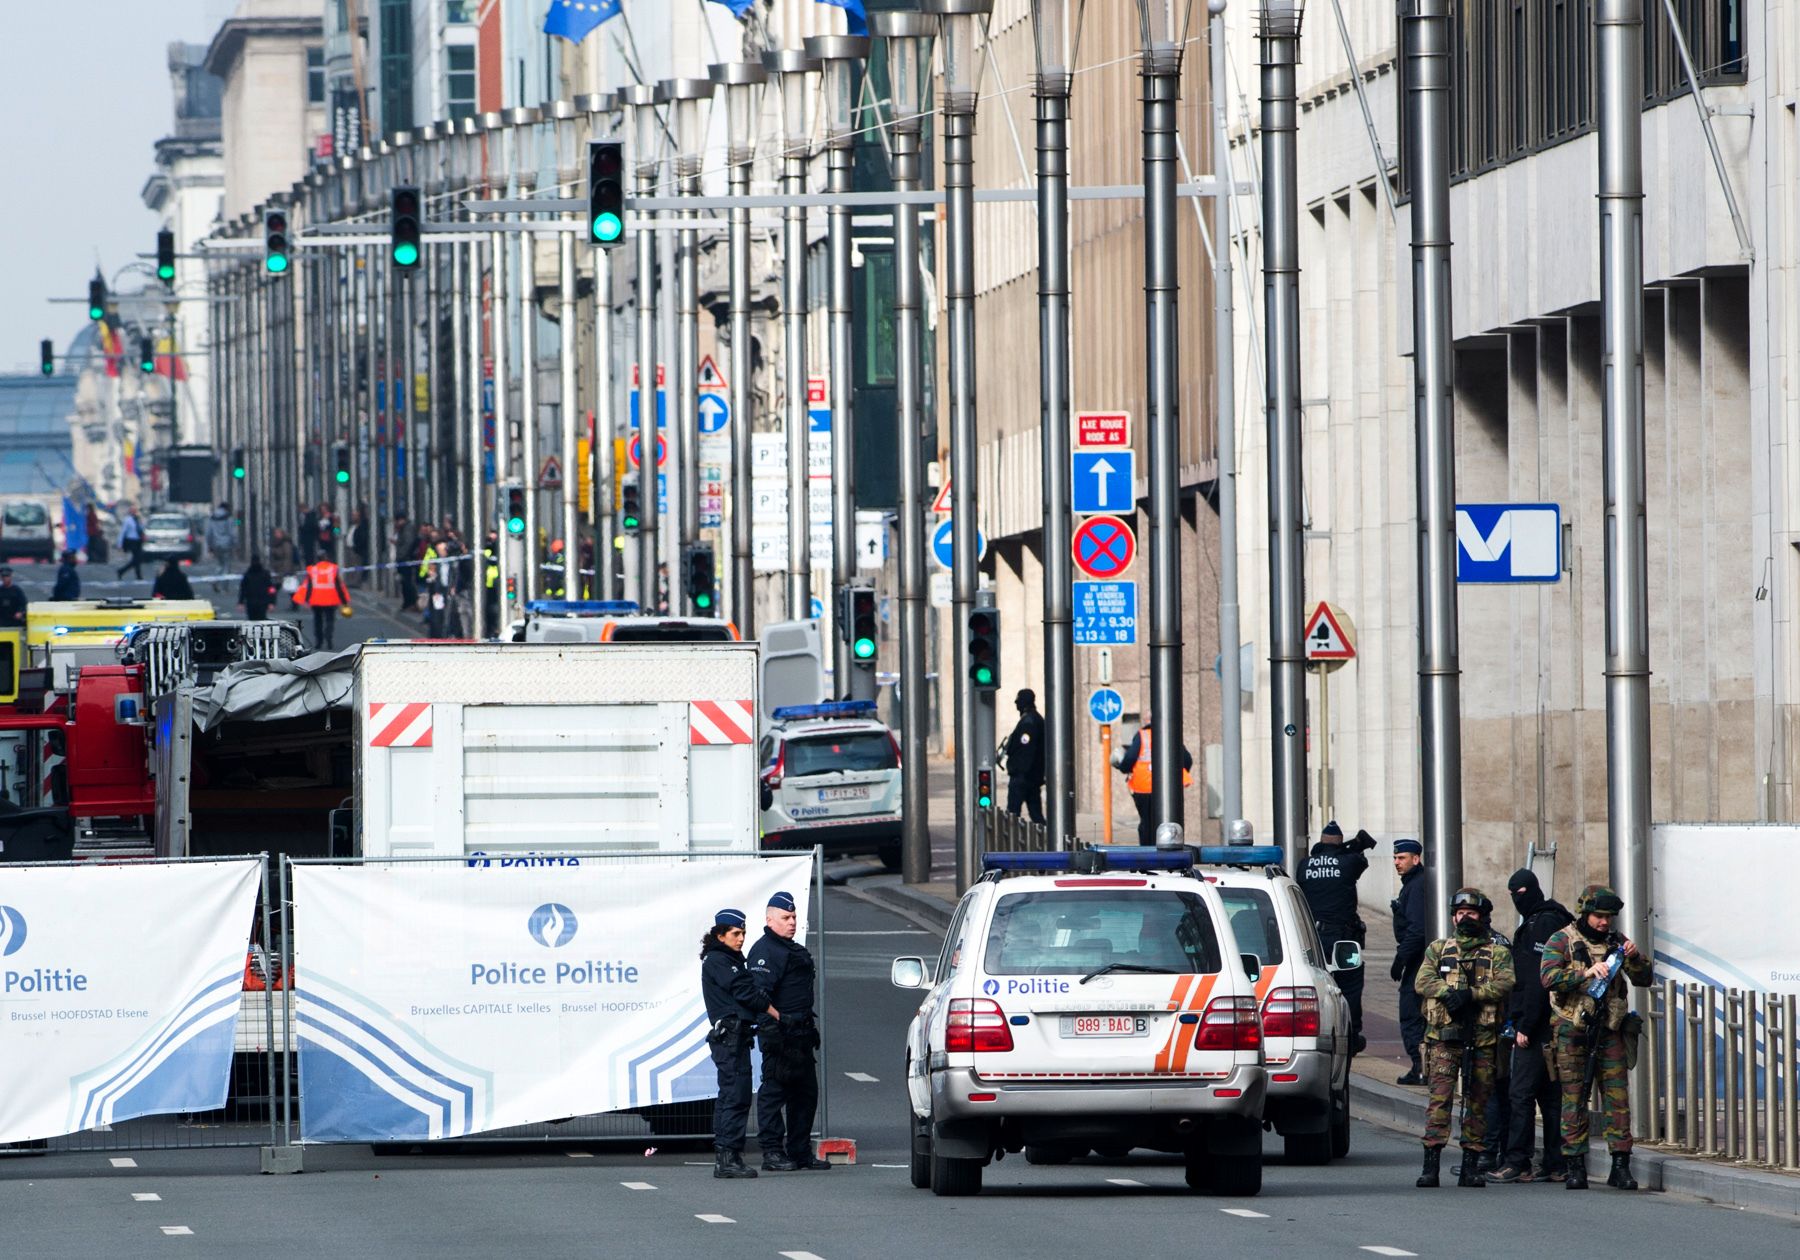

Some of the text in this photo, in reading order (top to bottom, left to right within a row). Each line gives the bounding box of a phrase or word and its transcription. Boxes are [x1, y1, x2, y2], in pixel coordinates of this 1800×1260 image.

[1081, 420, 1123, 429] AXE ROUGE
[1085, 432, 1120, 441] RODE AS
[1087, 617, 1096, 627] 7
[1109, 616, 1134, 627] 9.30
[1085, 630, 1098, 641] 13
[1115, 630, 1128, 641] 18
[801, 806, 829, 815] Politie
[1308, 856, 1339, 867] Police
[1305, 867, 1341, 879] Politie
[471, 960, 639, 985] Police Politie
[5, 968, 88, 992] Politie
[1008, 978, 1070, 994] Politie
[11, 1007, 149, 1021] Brussel HOOFDSTAD Elsene
[411, 1005, 461, 1016] Bruxelles
[463, 1003, 513, 1014] CAPITALE
[517, 1003, 551, 1014] Ixelles
[561, 1002, 597, 1013] Brussel
[1135, 1019, 1147, 1032] B
